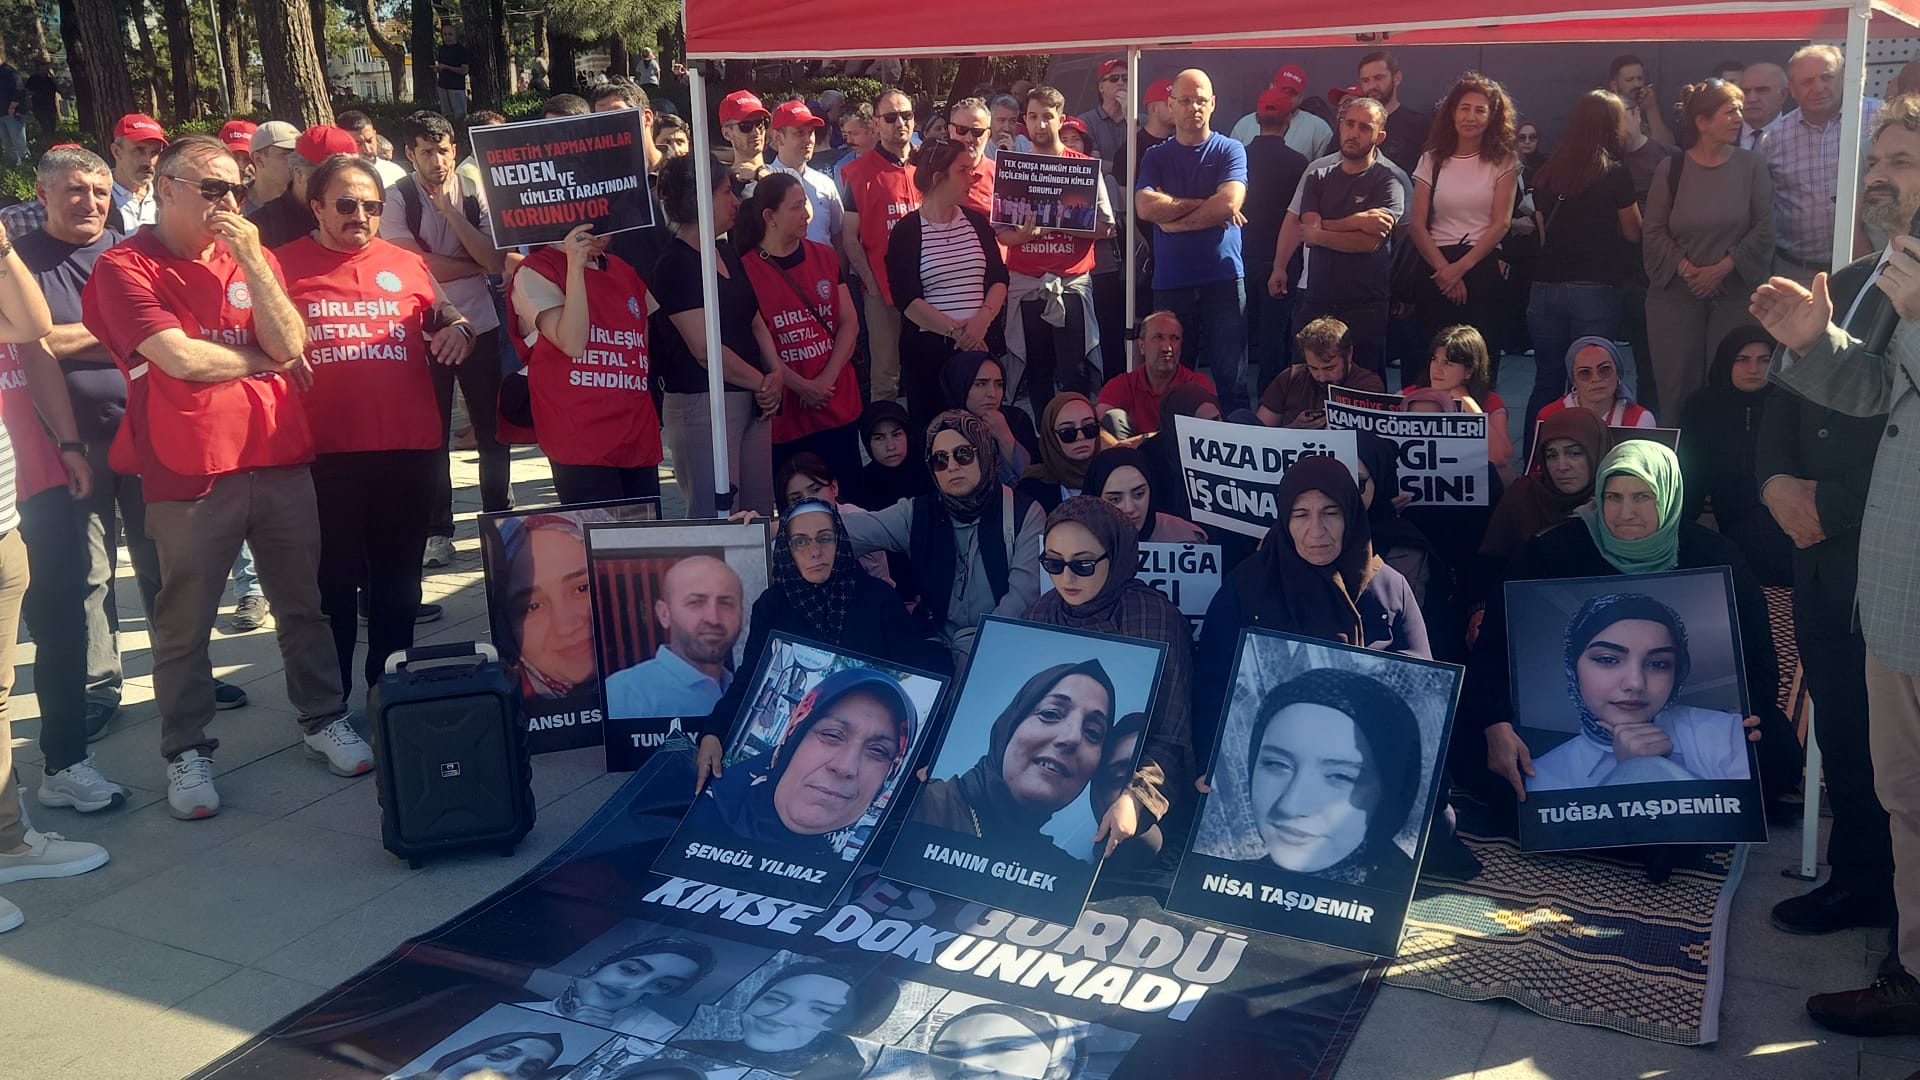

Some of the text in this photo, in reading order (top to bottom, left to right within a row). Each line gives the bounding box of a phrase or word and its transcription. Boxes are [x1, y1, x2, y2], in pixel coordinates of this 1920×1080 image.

[487, 131, 632, 164] DENETİM YAPMAYANLAR
[491, 160, 577, 187] NEDEN VE
[998, 169, 1095, 186] İŞÇİLERİN ÖLÜMÜNDEN KİMLER
[1004, 159, 1016, 168] TEK
[1068, 165, 1092, 174] EDİLEN
[519, 175, 638, 206] KİMLER TARAFINDAN
[1028, 186, 1063, 195] SORUMLU?
[501, 197, 610, 228] KORUNUYOR
[1021, 241, 1074, 254] SENDİKASI
[308, 298, 400, 319] BİRLEŞİK
[307, 322, 373, 342] METAL
[389, 319, 406, 342] İŞ
[590, 324, 645, 350] İRLEŞİK
[778, 326, 819, 345] METAL
[311, 341, 407, 365] SENDİKASI
[1328, 408, 1485, 438] KAMU GÖREVLİLERİ
[1189, 436, 1258, 471] KAZA
[1187, 470, 1279, 520] İŞ CİNA
[528, 712, 576, 732] ANSU
[1538, 793, 1742, 825] TUĞBA TAŞDEMİR
[685, 841, 829, 886] ŞENGÜL YILMAZ
[923, 843, 1058, 892] HANIM GÜLEK
[1202, 873, 1375, 924] NİSA TAŞDEMİR
[814, 905, 1210, 1022] DOKUNMADI
